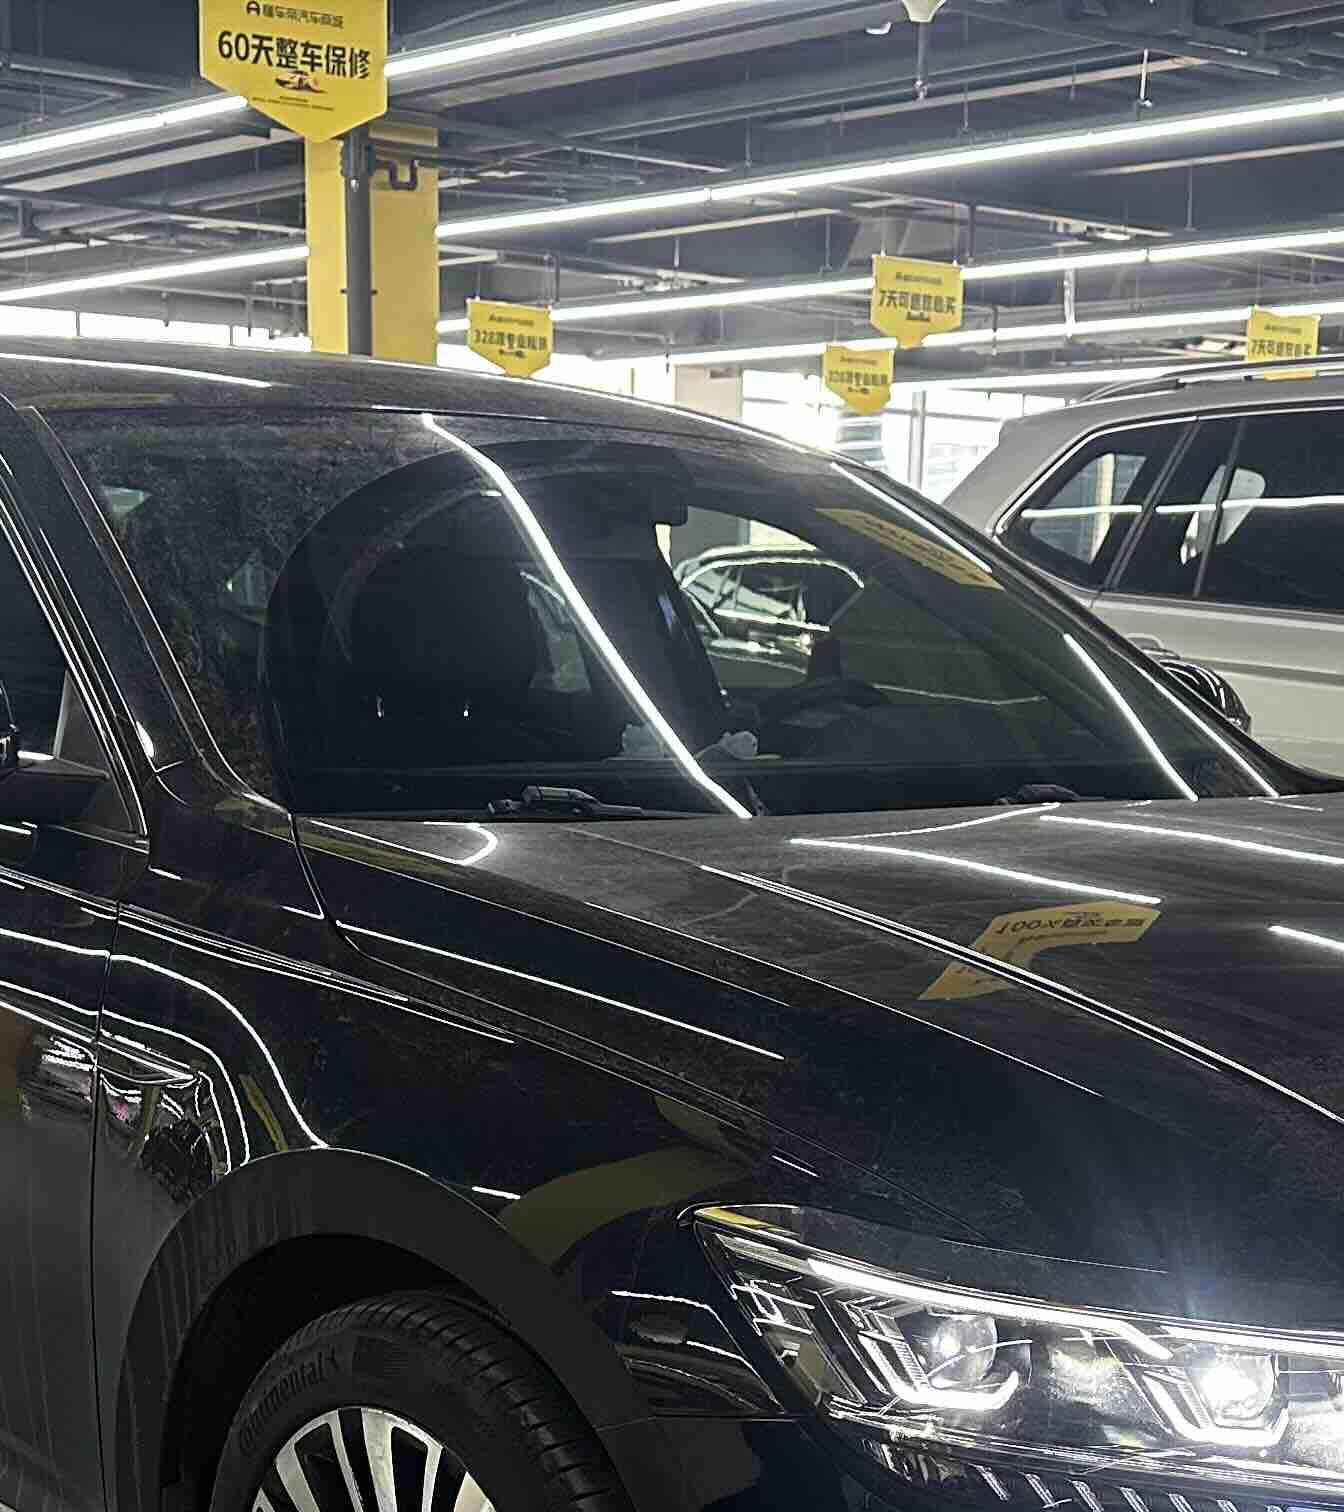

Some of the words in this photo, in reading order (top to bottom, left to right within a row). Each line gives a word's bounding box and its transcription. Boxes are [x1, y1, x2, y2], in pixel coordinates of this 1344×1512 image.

[218, 30, 371, 79] 60天整车保修
